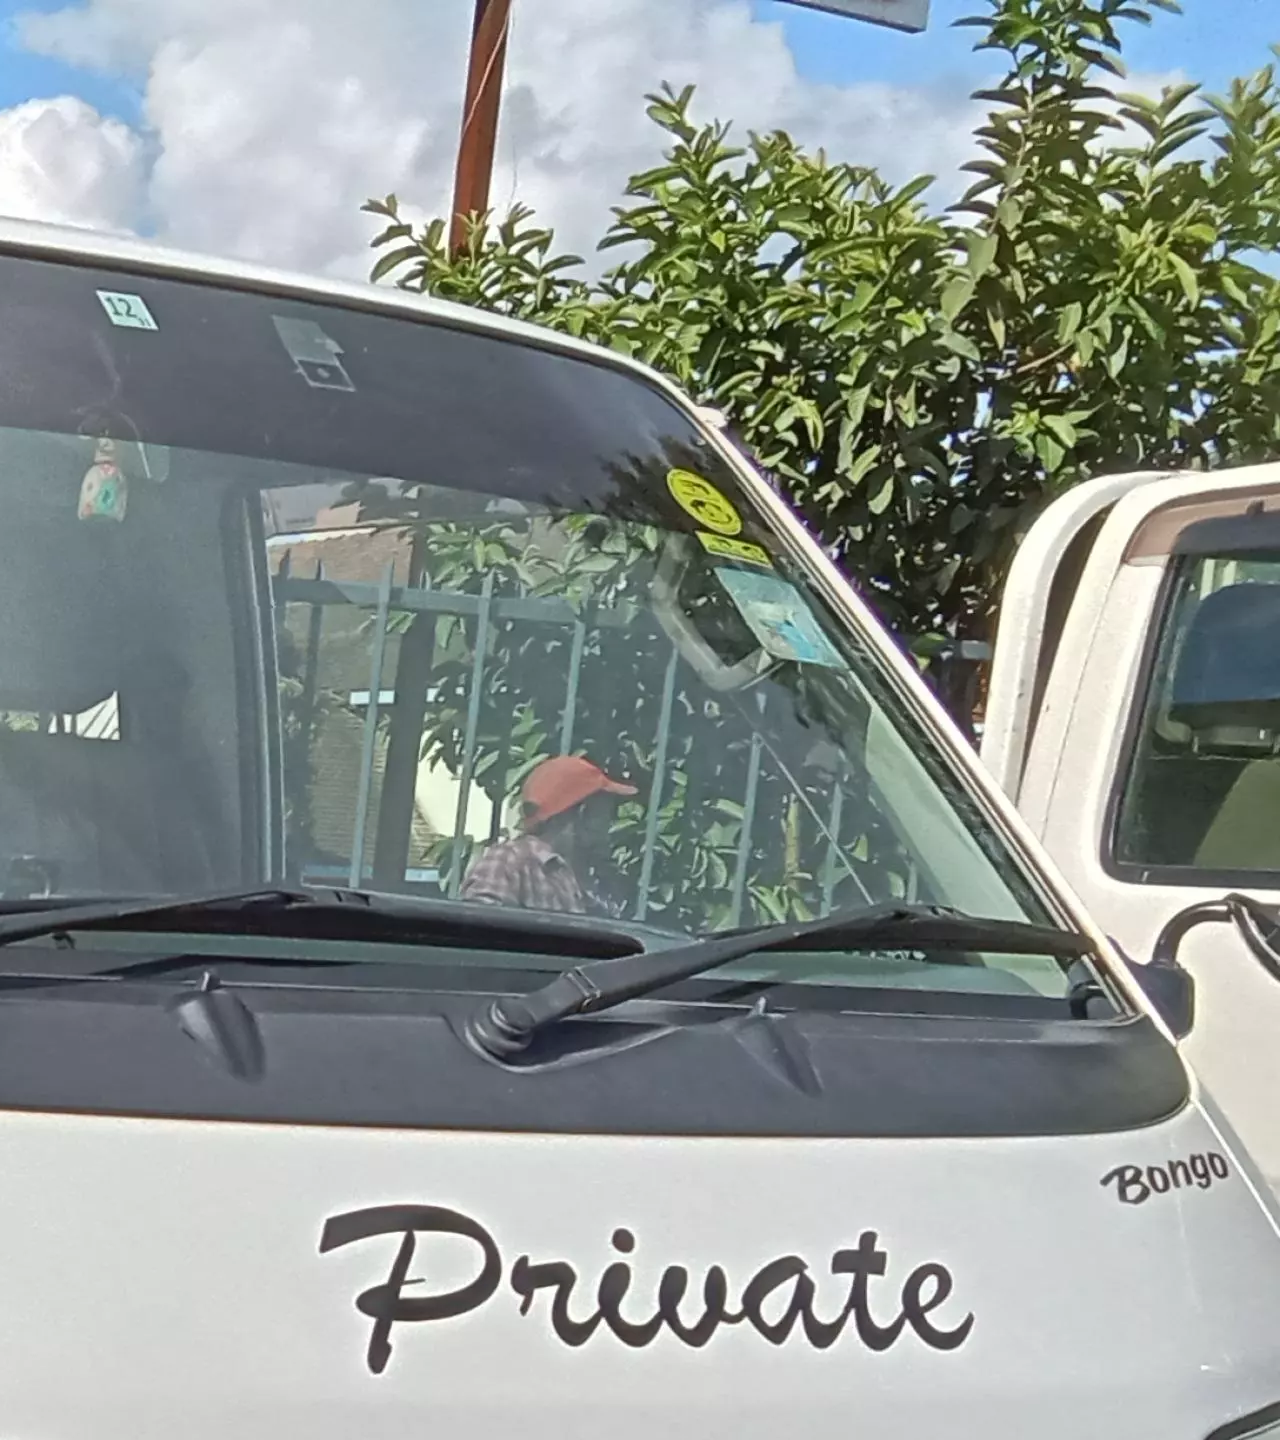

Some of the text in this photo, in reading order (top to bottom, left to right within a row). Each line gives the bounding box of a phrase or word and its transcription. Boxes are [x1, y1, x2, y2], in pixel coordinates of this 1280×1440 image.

[105, 296, 137, 318] 12
[1100, 1151, 1229, 1205] Bongo
[317, 1203, 975, 1374] Private
